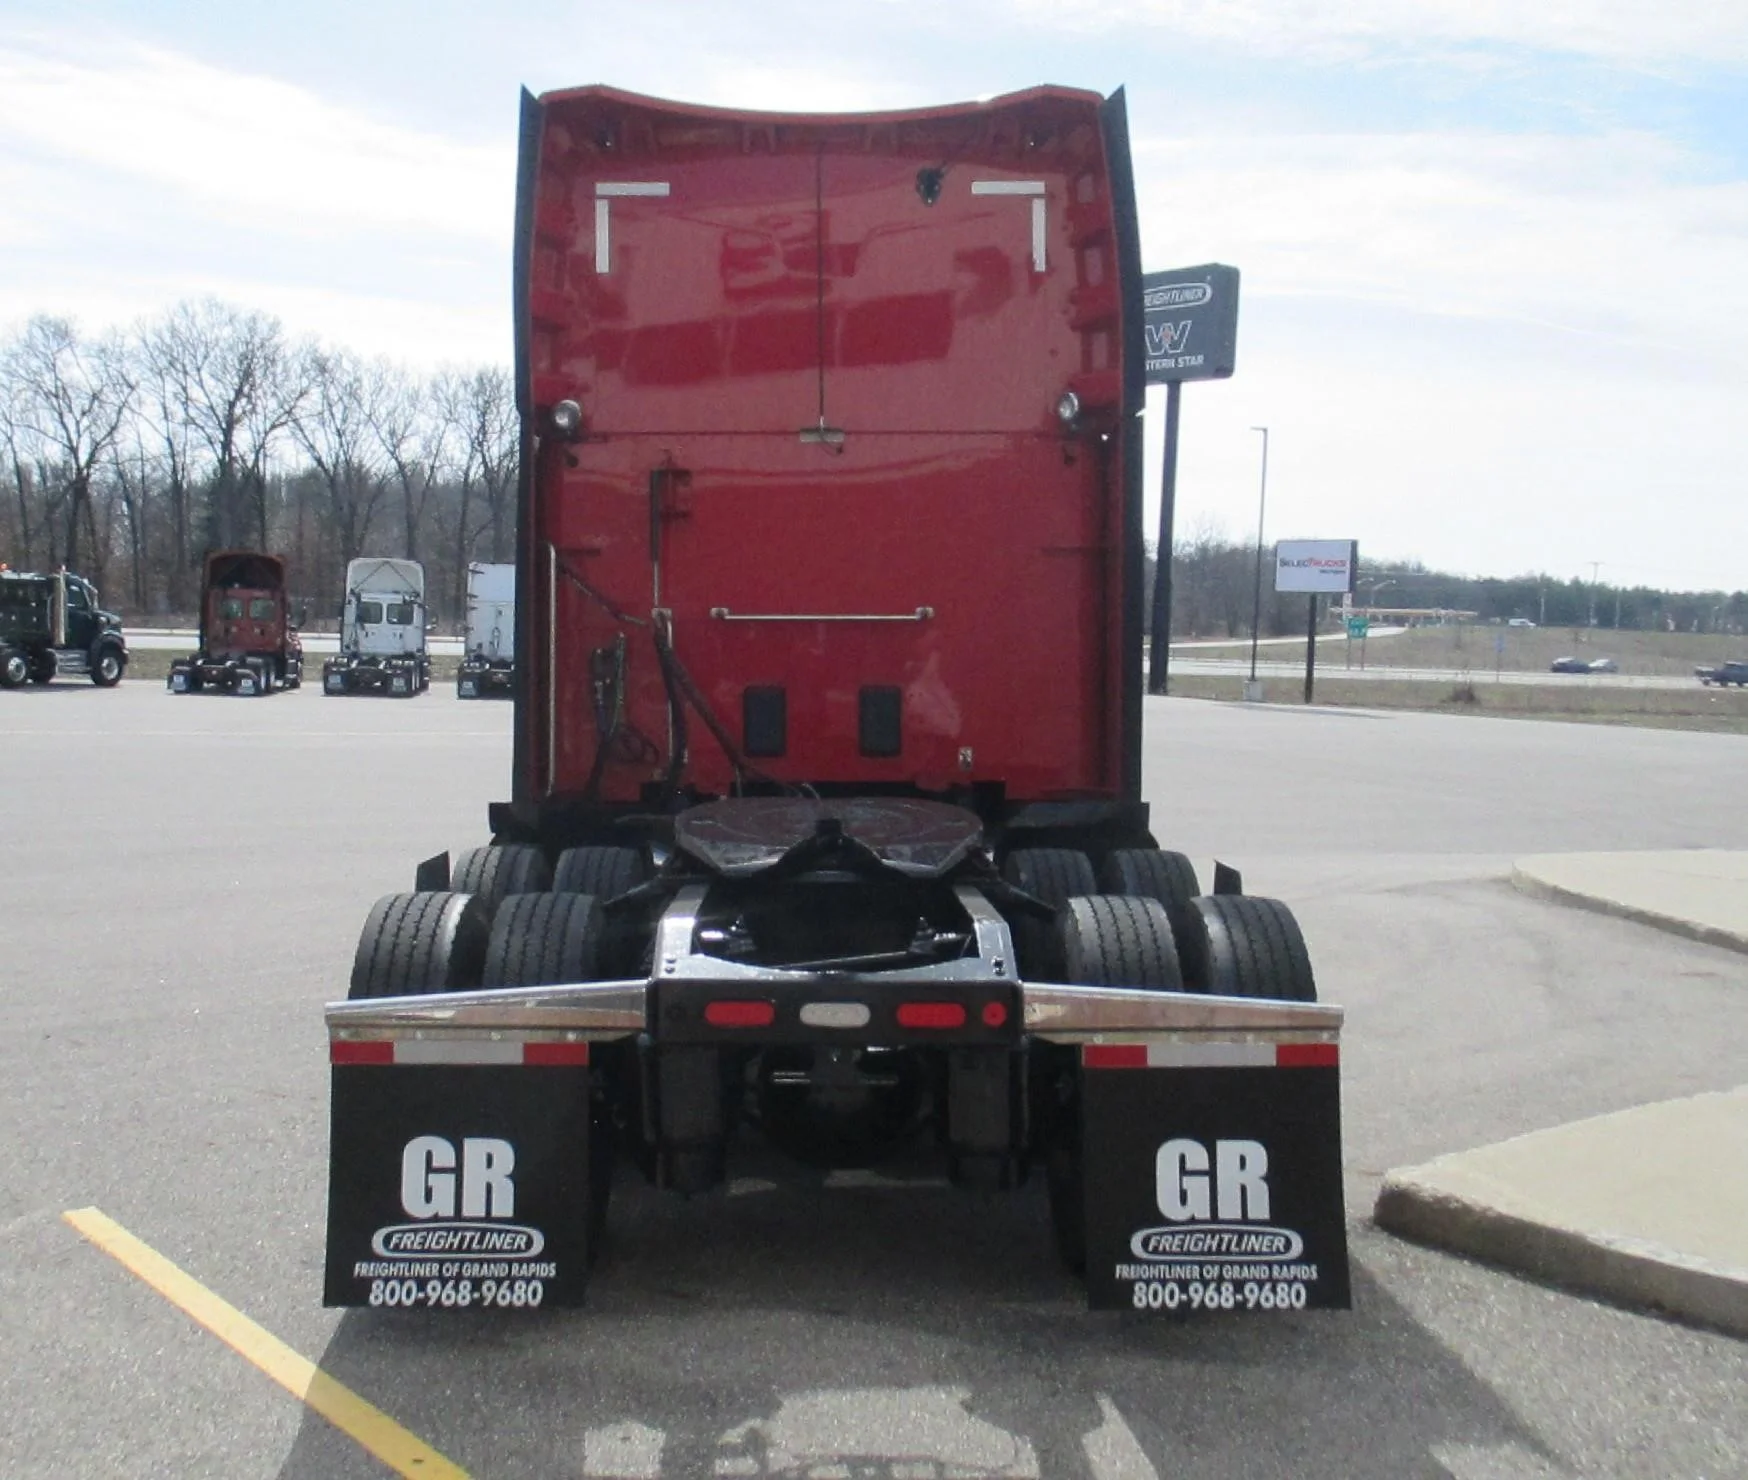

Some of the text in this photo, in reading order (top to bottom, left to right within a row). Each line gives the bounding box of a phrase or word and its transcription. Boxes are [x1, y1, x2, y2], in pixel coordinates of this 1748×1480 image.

[1144, 288, 1204, 305] EIGHTLINER
[1177, 354, 1204, 368] STAR
[401, 1135, 515, 1219] GR
[1155, 1138, 1271, 1222] GR
[389, 1231, 527, 1250] FREIGHTLINER
[1148, 1233, 1285, 1252] FREIGHTLINER
[353, 1262, 556, 1277] FREIGHTLINER OF GRAND RAPIDS
[1115, 1264, 1319, 1280] FREIGHTLINER OF GRAND RAPIDS
[368, 1280, 543, 1306] 800-968-9680
[1132, 1282, 1307, 1309] 800-968-9680
